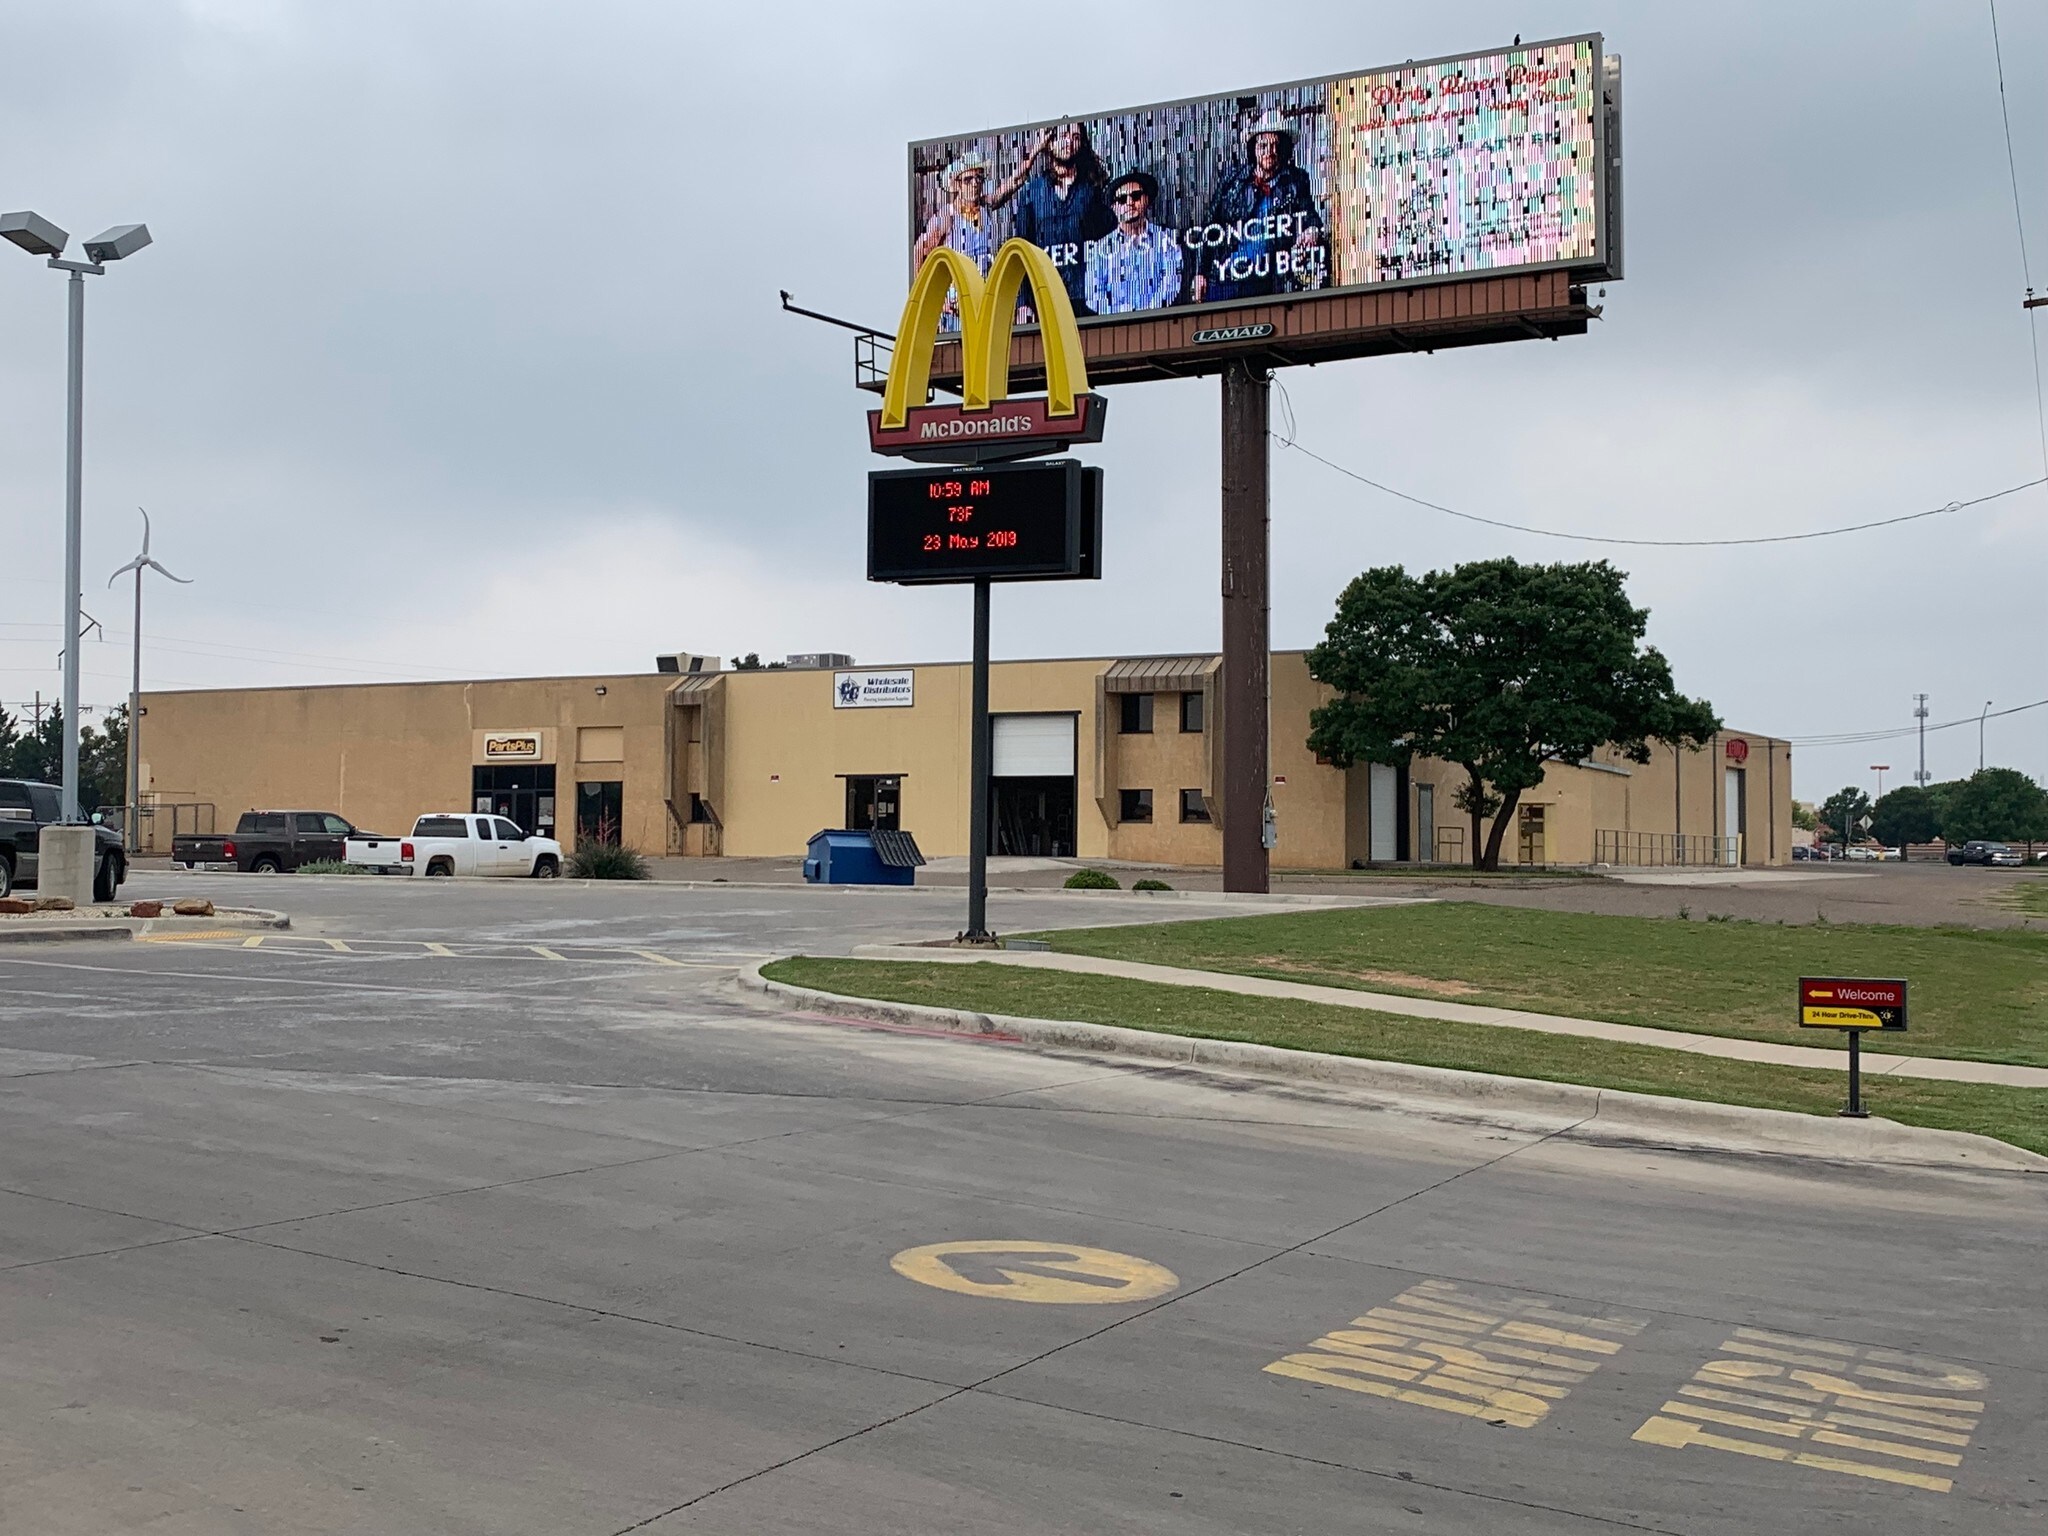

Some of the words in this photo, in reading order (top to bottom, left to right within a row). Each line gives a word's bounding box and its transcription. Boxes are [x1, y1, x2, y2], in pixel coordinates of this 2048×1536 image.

[1440, 74, 1500, 96] River
[1505, 64, 1558, 86] Boys
[1185, 211, 1308, 249] CONCERT
[1214, 252, 1270, 282] YOU
[1276, 245, 1327, 275] BET!
[1198, 325, 1265, 342] LAMAR
[919, 415, 1033, 439] McDonald's
[929, 481, 962, 498] 10:59
[970, 480, 990, 496] AM
[948, 506, 974, 522] 73F
[924, 534, 941, 550] 23
[949, 533, 979, 549] May
[987, 531, 1017, 547] 2019
[863, 686, 911, 694] Distributors
[867, 677, 909, 686] Wholesale
[1837, 989, 1895, 1001] Welcome
[1262, 1280, 1652, 1429] DRIVE
[1631, 1327, 1992, 1493] THRU
